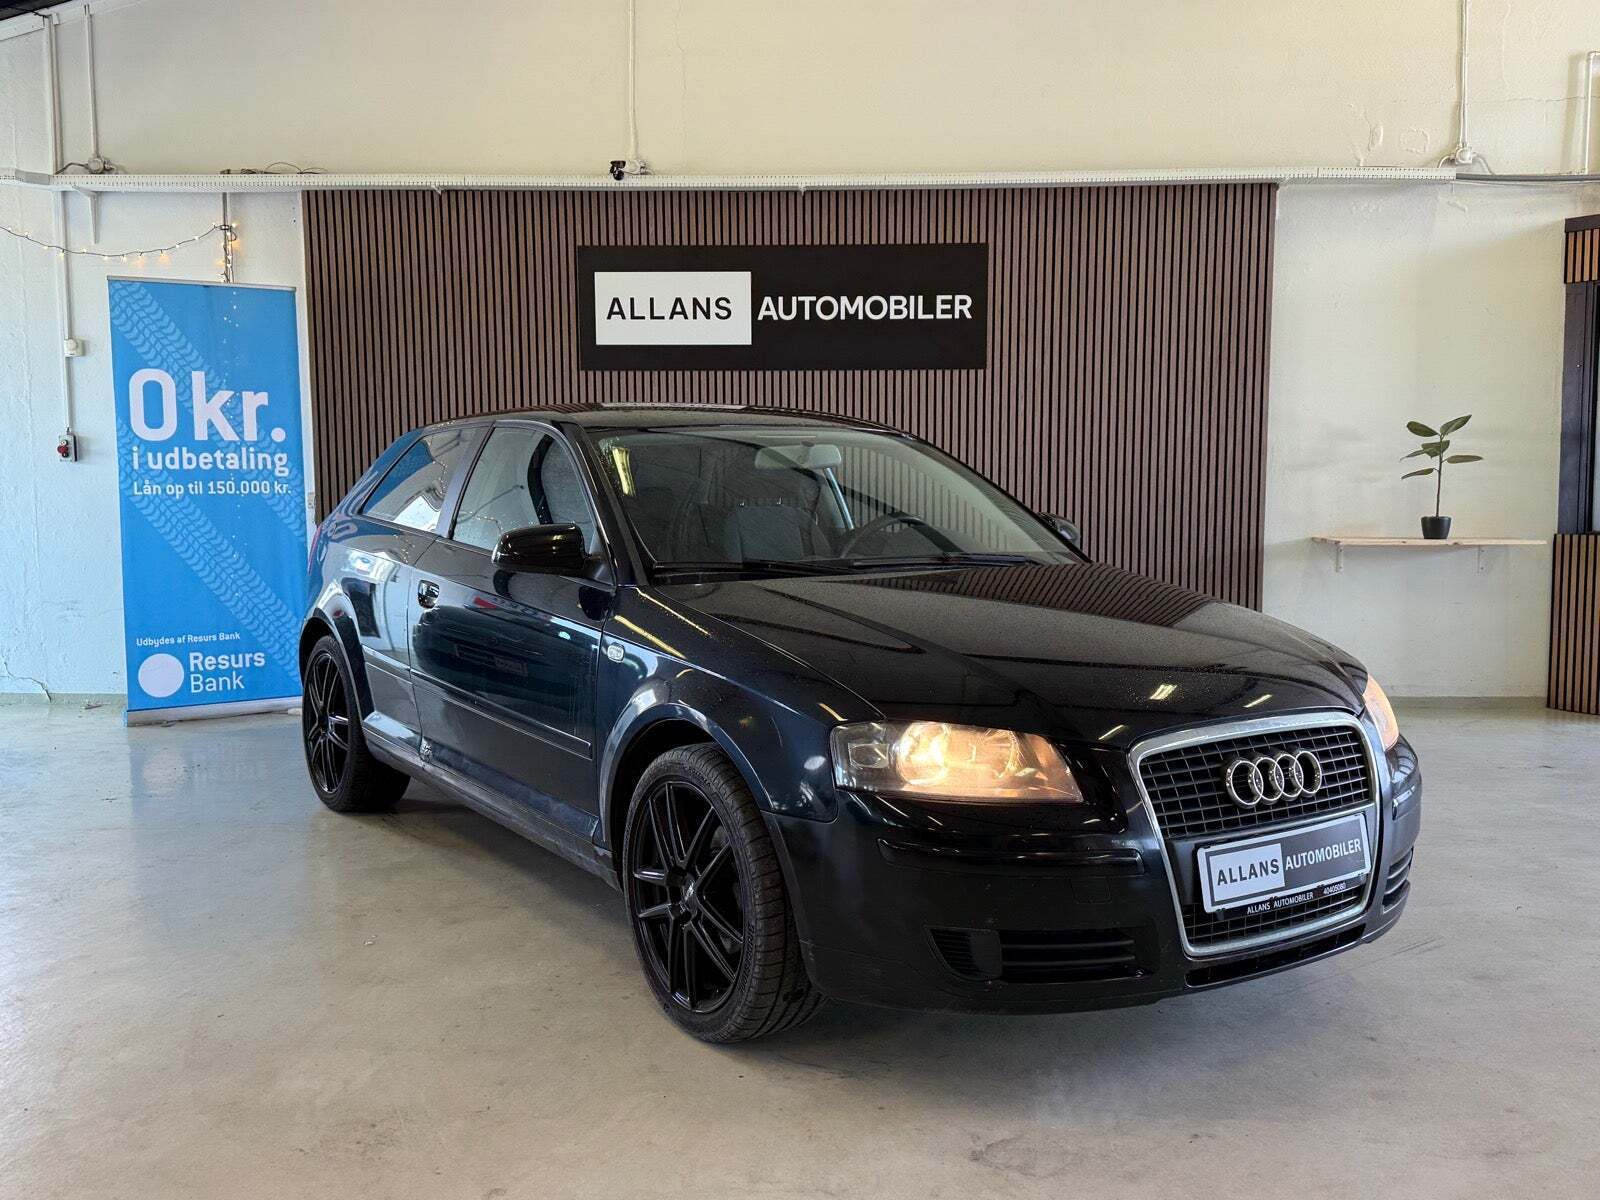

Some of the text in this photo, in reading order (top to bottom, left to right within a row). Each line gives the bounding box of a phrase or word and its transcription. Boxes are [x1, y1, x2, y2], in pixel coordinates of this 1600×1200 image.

[606, 294, 973, 321] ALLANS AUTOMOBILER
[128, 368, 286, 442] 0 kr.
[132, 446, 290, 477] i udbetaling
[134, 479, 292, 499] Lån op til 150.000 kr.
[136, 631, 241, 648] Udbydes af Resurs Bank
[189, 651, 266, 673] Resurs
[190, 671, 245, 693] Bank
[1217, 838, 1362, 886] ALLANS AUTOMOBILER
[1247, 901, 1271, 915] ALLANS
[1273, 891, 1314, 909] AUTOMOBILER
